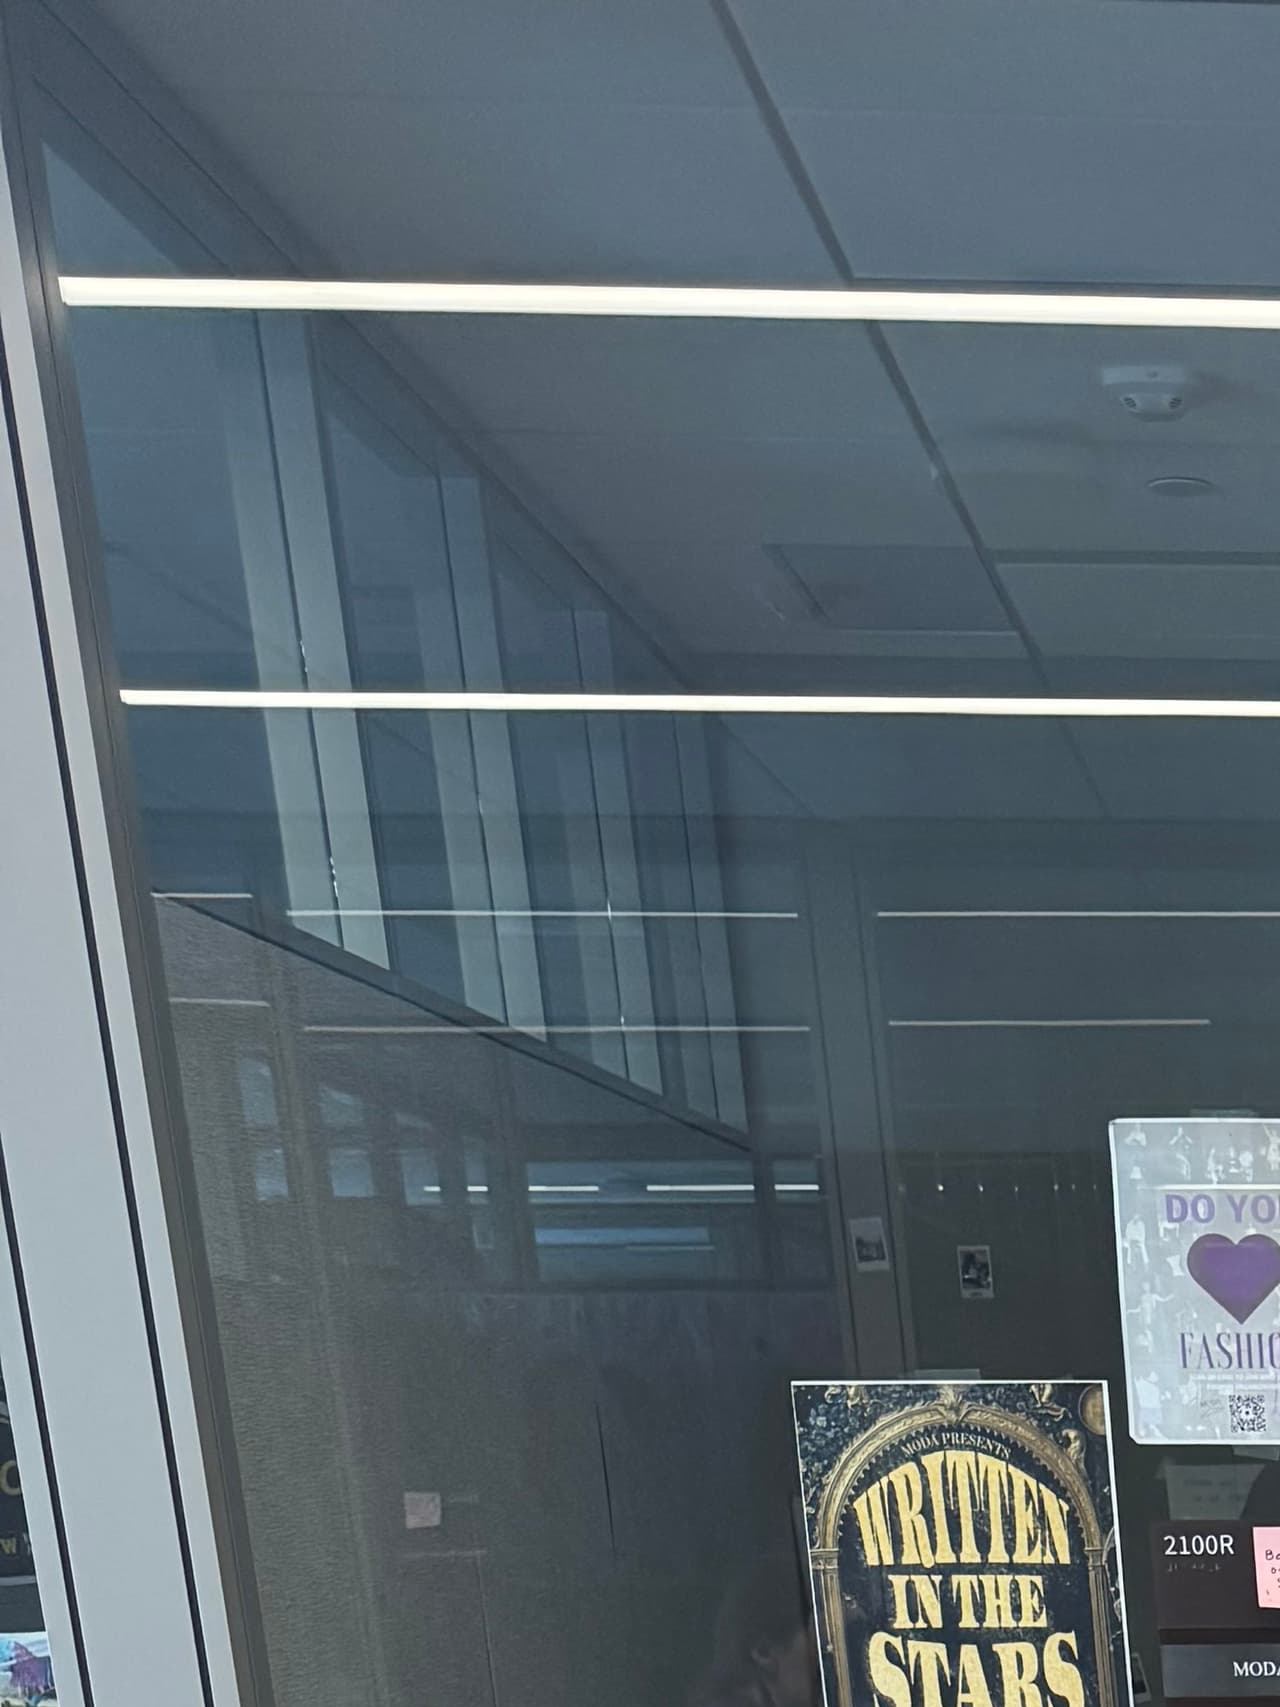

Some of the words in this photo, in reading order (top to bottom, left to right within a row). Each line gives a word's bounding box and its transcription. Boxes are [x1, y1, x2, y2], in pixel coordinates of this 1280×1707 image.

[1165, 1194, 1215, 1224] DO
[901, 1435, 939, 1458] MODA
[941, 1432, 1011, 1458] PRESENTS
[852, 1449, 1072, 1568] WRITTEN
[1163, 1534, 1235, 1556] 2100R
[887, 1574, 944, 1629] IN
[952, 1574, 1048, 1629] THE
